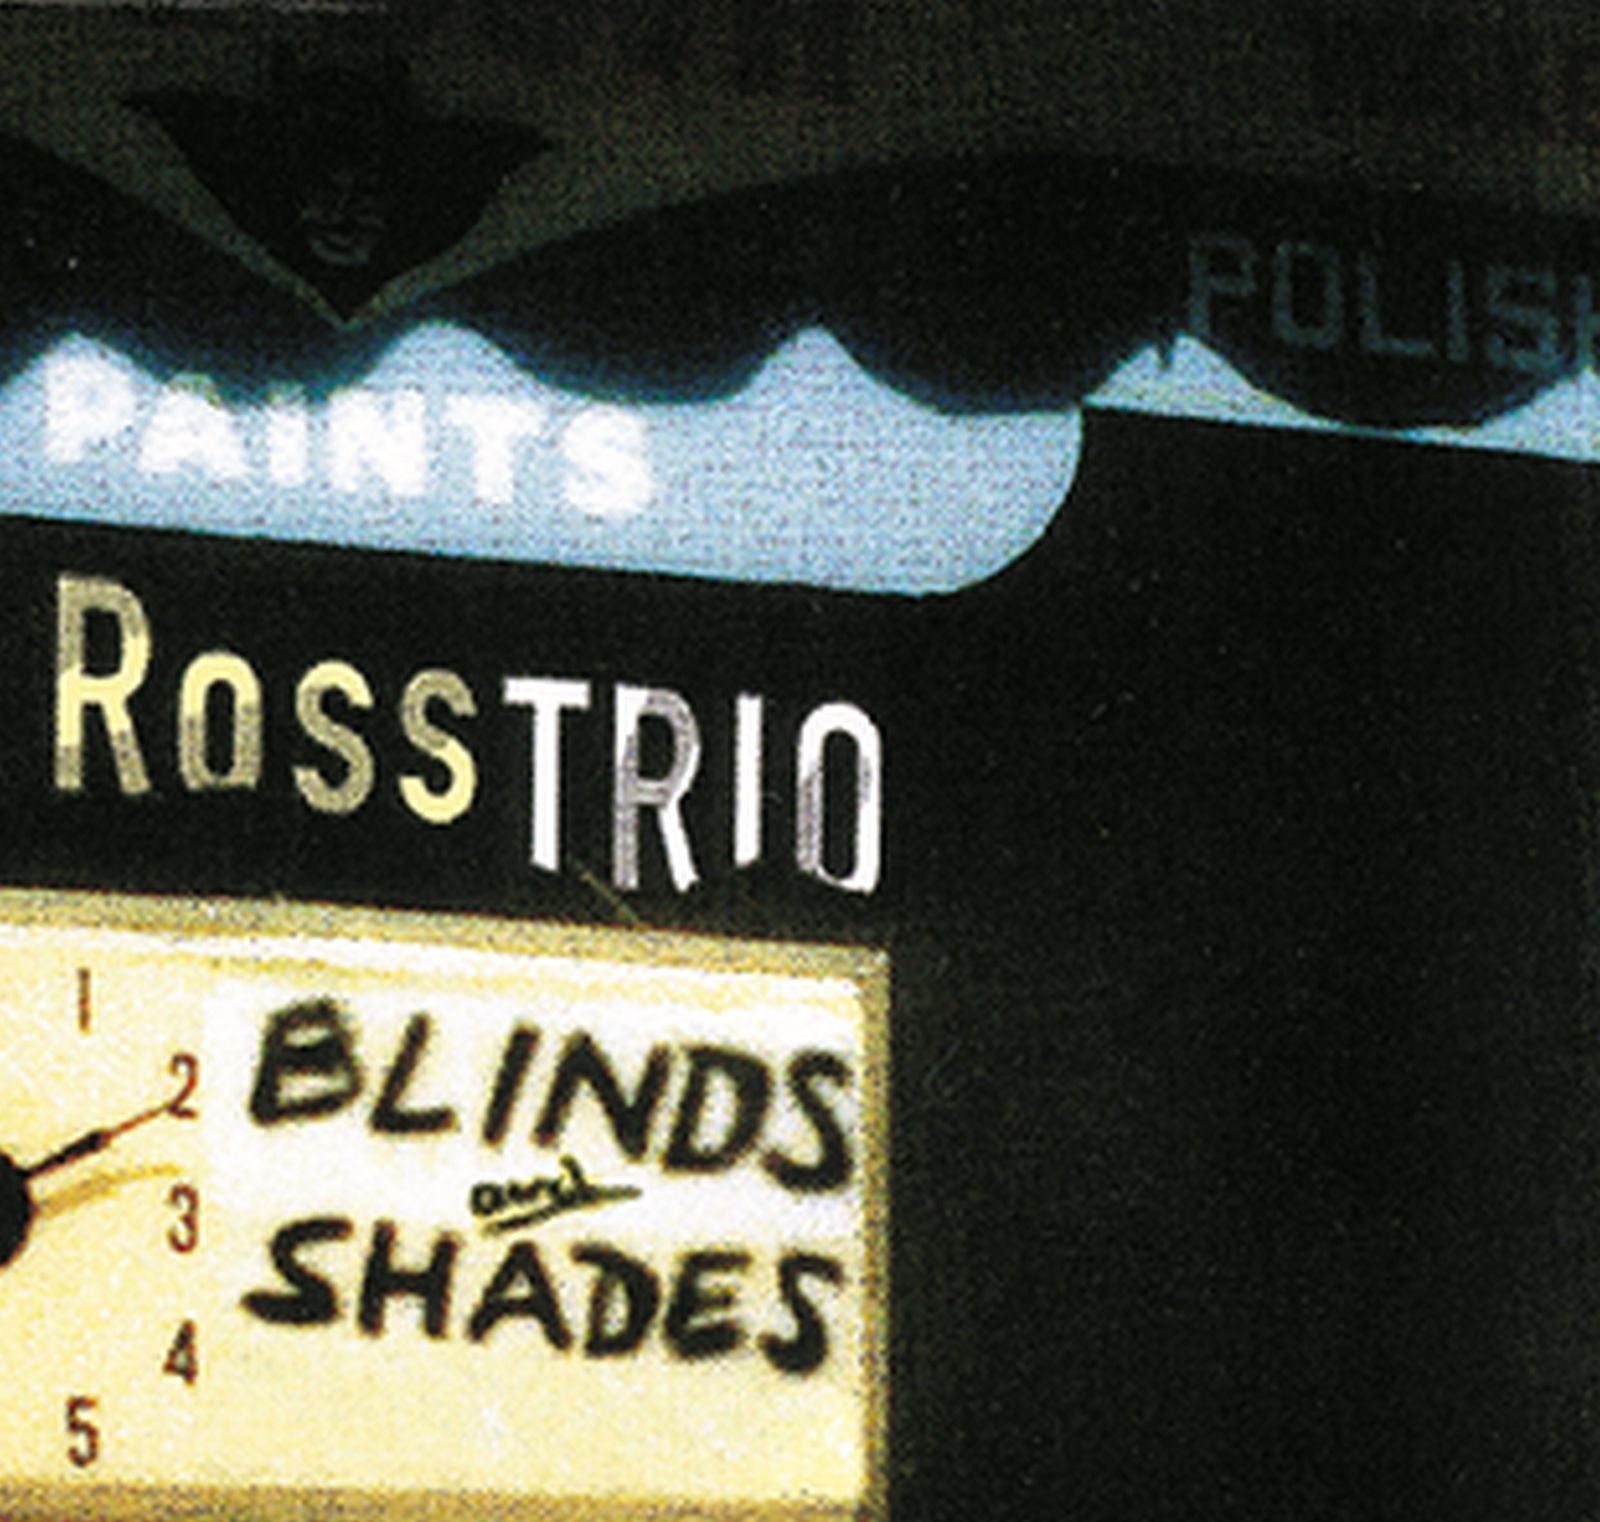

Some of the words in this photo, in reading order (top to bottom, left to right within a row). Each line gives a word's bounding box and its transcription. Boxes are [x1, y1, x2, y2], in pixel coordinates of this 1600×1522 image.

[42, 348, 654, 520] PAINTS
[76, 966, 92, 1034] 1
[165, 1051, 199, 1120] 2
[247, 995, 855, 1195] BLINDS
[166, 1184, 199, 1254] 3
[467, 1152, 643, 1219] and
[240, 1215, 846, 1379] SHADES
[163, 1319, 198, 1387] 4
[65, 1395, 99, 1468] 5
